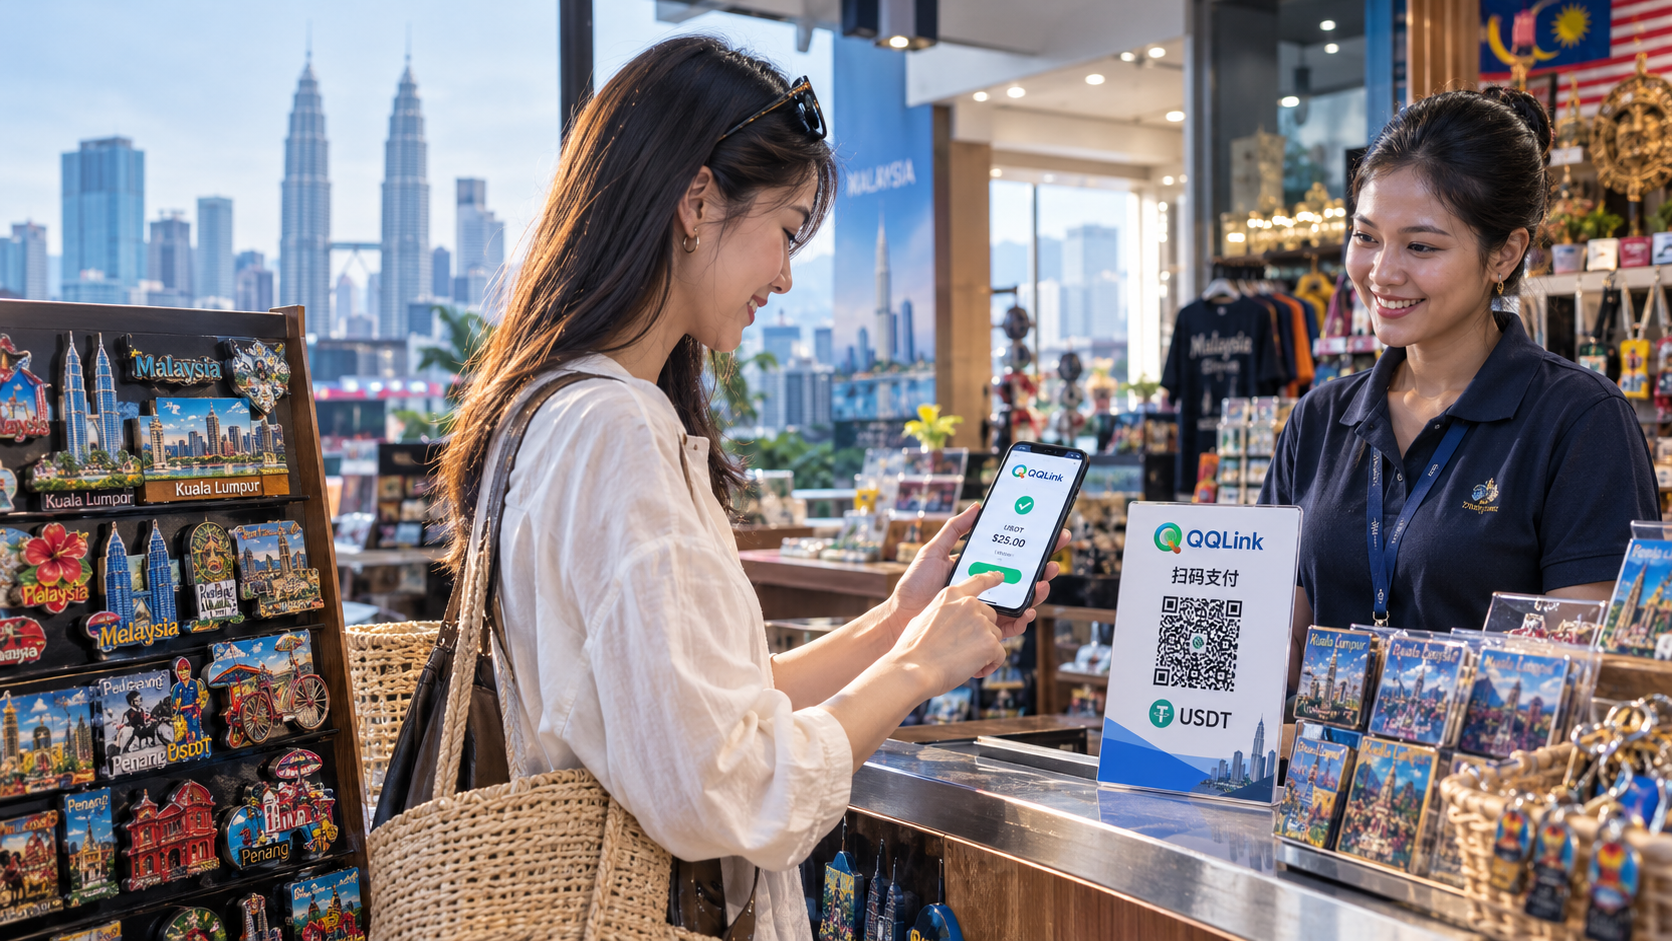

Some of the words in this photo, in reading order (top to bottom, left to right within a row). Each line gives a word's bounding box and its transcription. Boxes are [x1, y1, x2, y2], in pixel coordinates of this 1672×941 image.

[135, 355, 222, 384] Malaysia
[1028, 468, 1064, 483] QQLink
[175, 481, 211, 497] Kuala
[215, 481, 260, 496] Lumpur
[45, 493, 83, 509] Kuala
[992, 533, 1026, 548] $25.00
[1187, 529, 1264, 551] QQLink
[1171, 566, 1240, 587] 扫码支付
[1180, 707, 1233, 729] USDT
[242, 843, 289, 867] Penang
